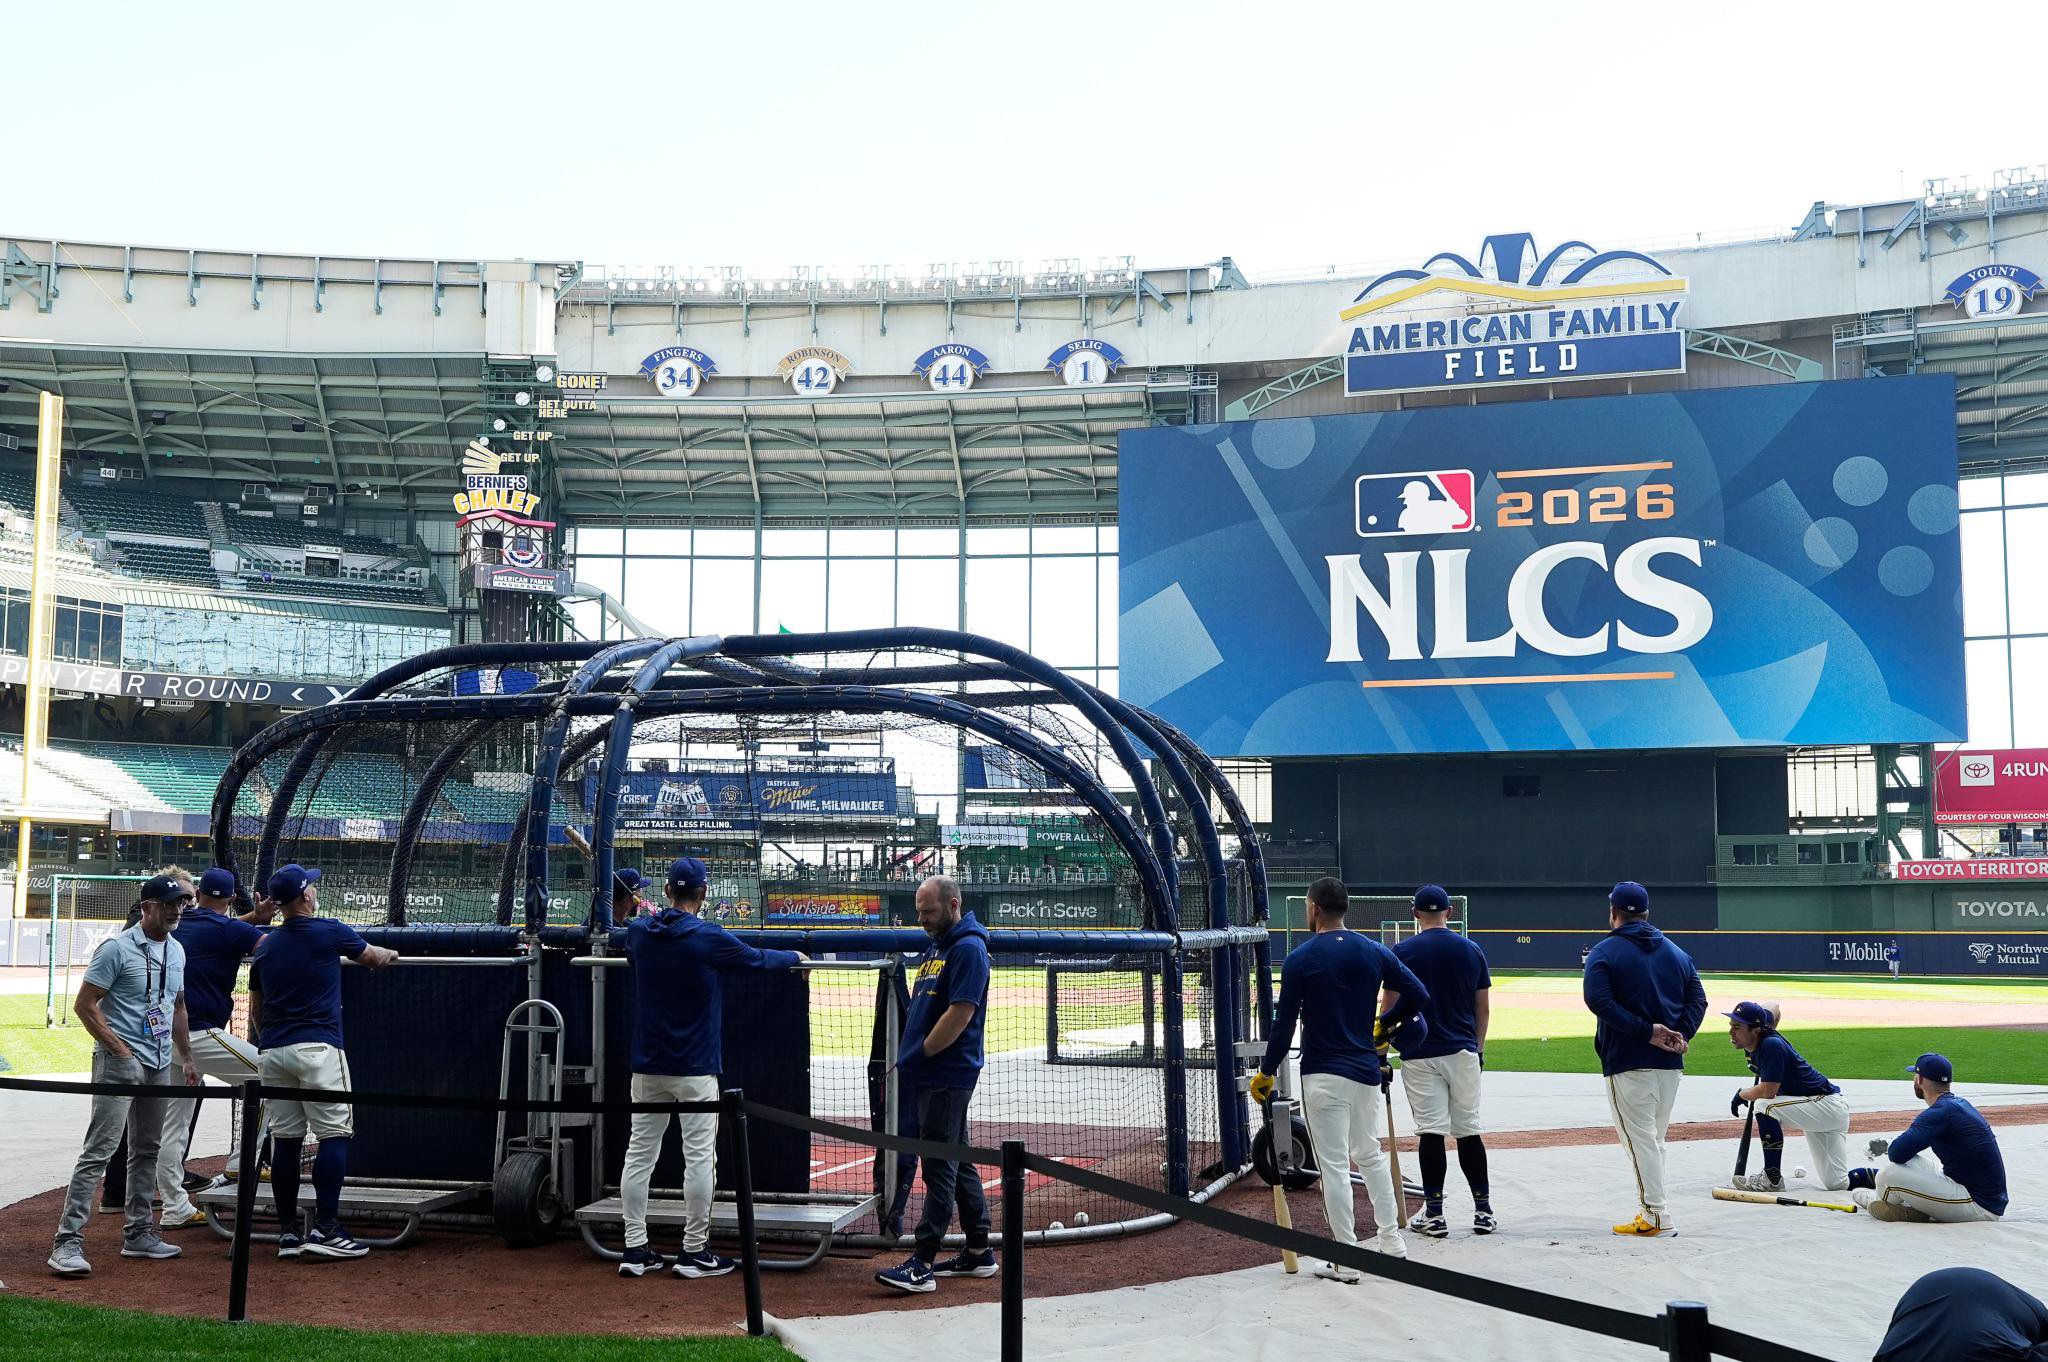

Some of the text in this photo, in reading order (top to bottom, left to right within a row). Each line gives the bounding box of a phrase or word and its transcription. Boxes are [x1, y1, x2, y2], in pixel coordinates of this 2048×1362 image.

[1967, 266, 2019, 281] YOUNT
[1973, 286, 2015, 315] 19
[1349, 301, 1680, 353] AMERICAN FAMILY
[932, 346, 971, 358] AARON
[1068, 340, 1103, 352] SELIG
[653, 348, 704, 362] FINGERS
[787, 348, 842, 364] ROBINSON
[1445, 343, 1577, 379] FIELD
[661, 366, 694, 389] 34
[798, 366, 831, 390] 42
[934, 363, 968, 387] 44
[1079, 360, 1092, 384] 1
[556, 375, 607, 389] GONE!
[539, 400, 597, 410] GET OUTTA
[538, 409, 567, 418] HERE
[513, 432, 552, 441] GET UP
[500, 453, 522, 462] GET
[102, 469, 115, 477] 441
[467, 475, 527, 490] BERNIE'S
[453, 489, 541, 516] CHALET
[1496, 484, 1675, 528] 2026
[304, 506, 318, 514] 442
[493, 575, 528, 583] AMERICAN
[497, 582, 549, 590] INSURANCE
[1325, 536, 1714, 663] NLCS
[1, 661, 273, 701] PN YEAR ROUND
[2001, 762, 2048, 777] 4RUN
[761, 784, 818, 809] Miller
[790, 799, 820, 812] TIME,
[624, 820, 650, 828] GREAT
[651, 820, 677, 828] TASTE.
[679, 820, 698, 828] LESS
[1936, 813, 1977, 821] COURTESY
[962, 832, 1003, 841] Associated
[1037, 832, 1071, 842] POWER
[1901, 863, 1965, 878] TOYOTA
[779, 898, 836, 916] Surfside
[1053, 902, 1098, 918] Save
[1957, 900, 2048, 918] TOYOTA.
[22, 927, 39, 937] 342
[1516, 936, 1531, 944] 400
[1997, 954, 2041, 964] Mutual
